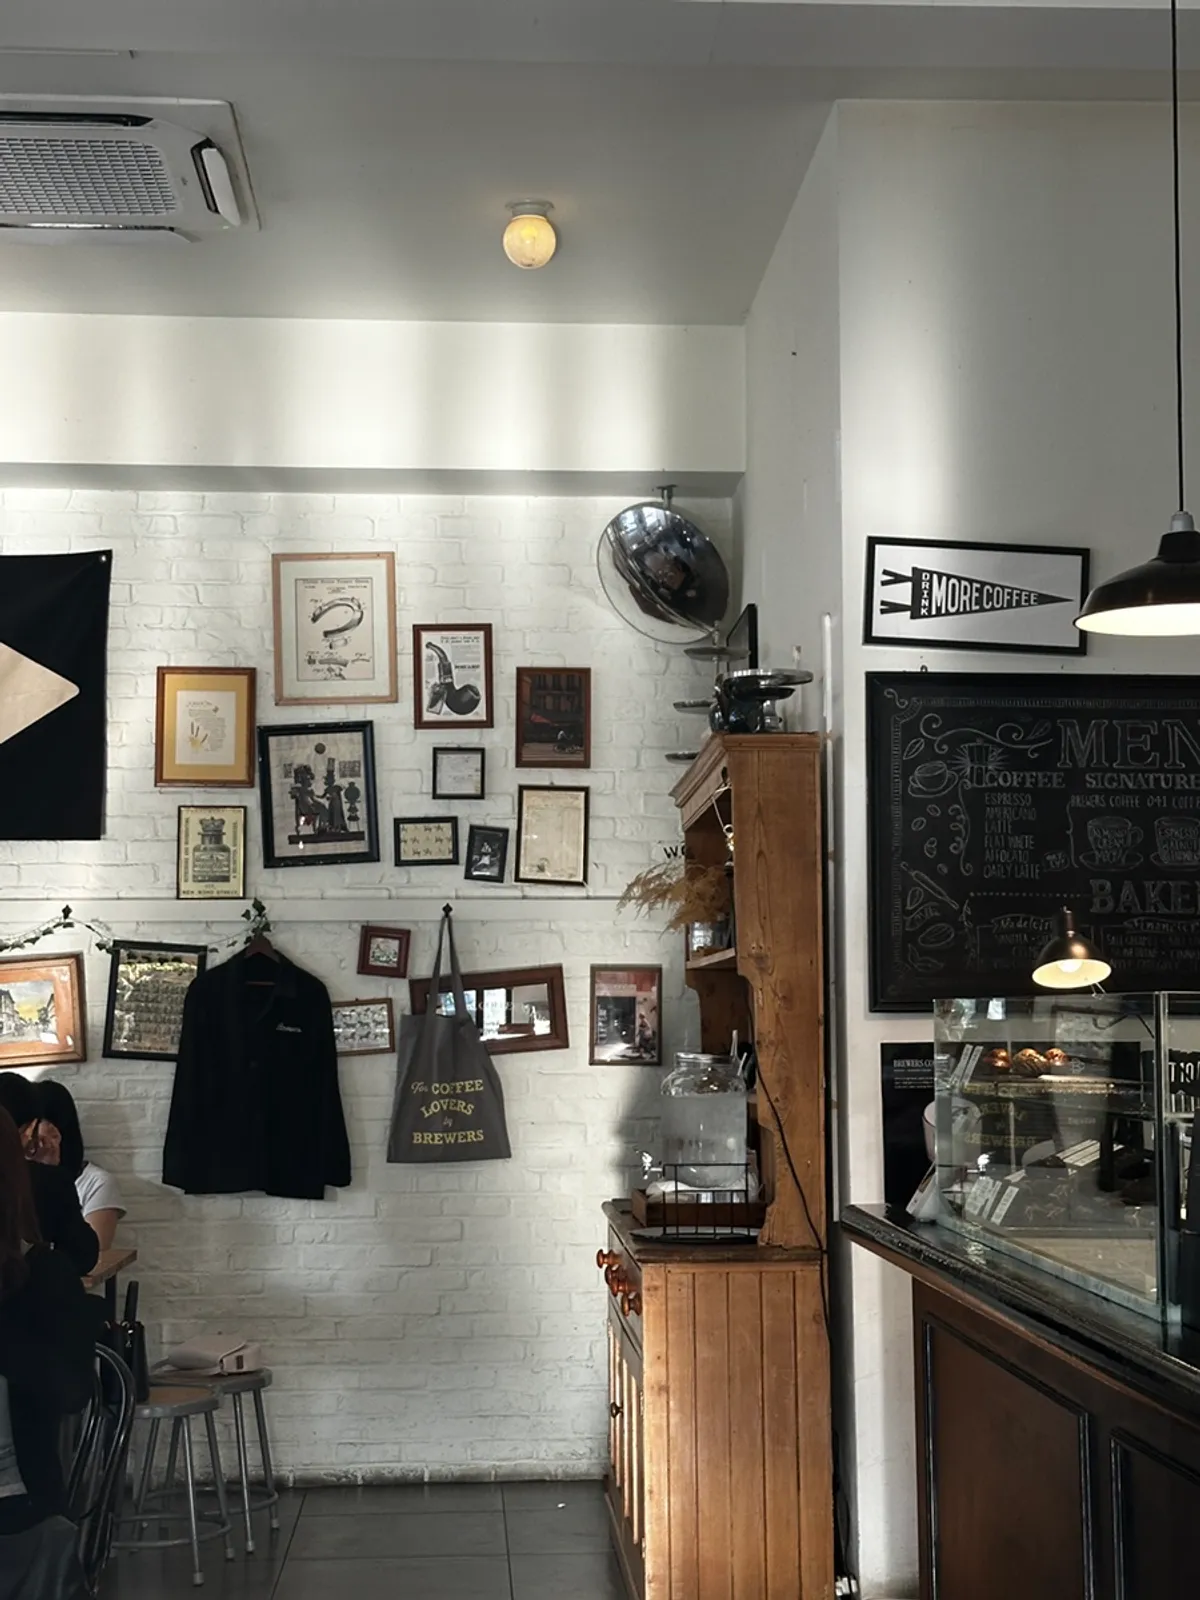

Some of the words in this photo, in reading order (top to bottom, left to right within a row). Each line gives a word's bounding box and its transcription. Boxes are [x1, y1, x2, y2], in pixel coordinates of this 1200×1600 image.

[920, 572, 930, 616] DRINK
[931, 573, 981, 615] MORE
[982, 585, 1039, 609] COFFEE
[985, 770, 1066, 788] COFFEE
[984, 792, 1032, 806] ESPRESSO
[985, 807, 1036, 821] AMERICANO
[985, 820, 1012, 834] LATTE
[1089, 878, 1200, 915] BAKE
[431, 1079, 484, 1095] COFFEE
[420, 1098, 475, 1118] LOVERS
[412, 1129, 484, 1145] BREWERS
